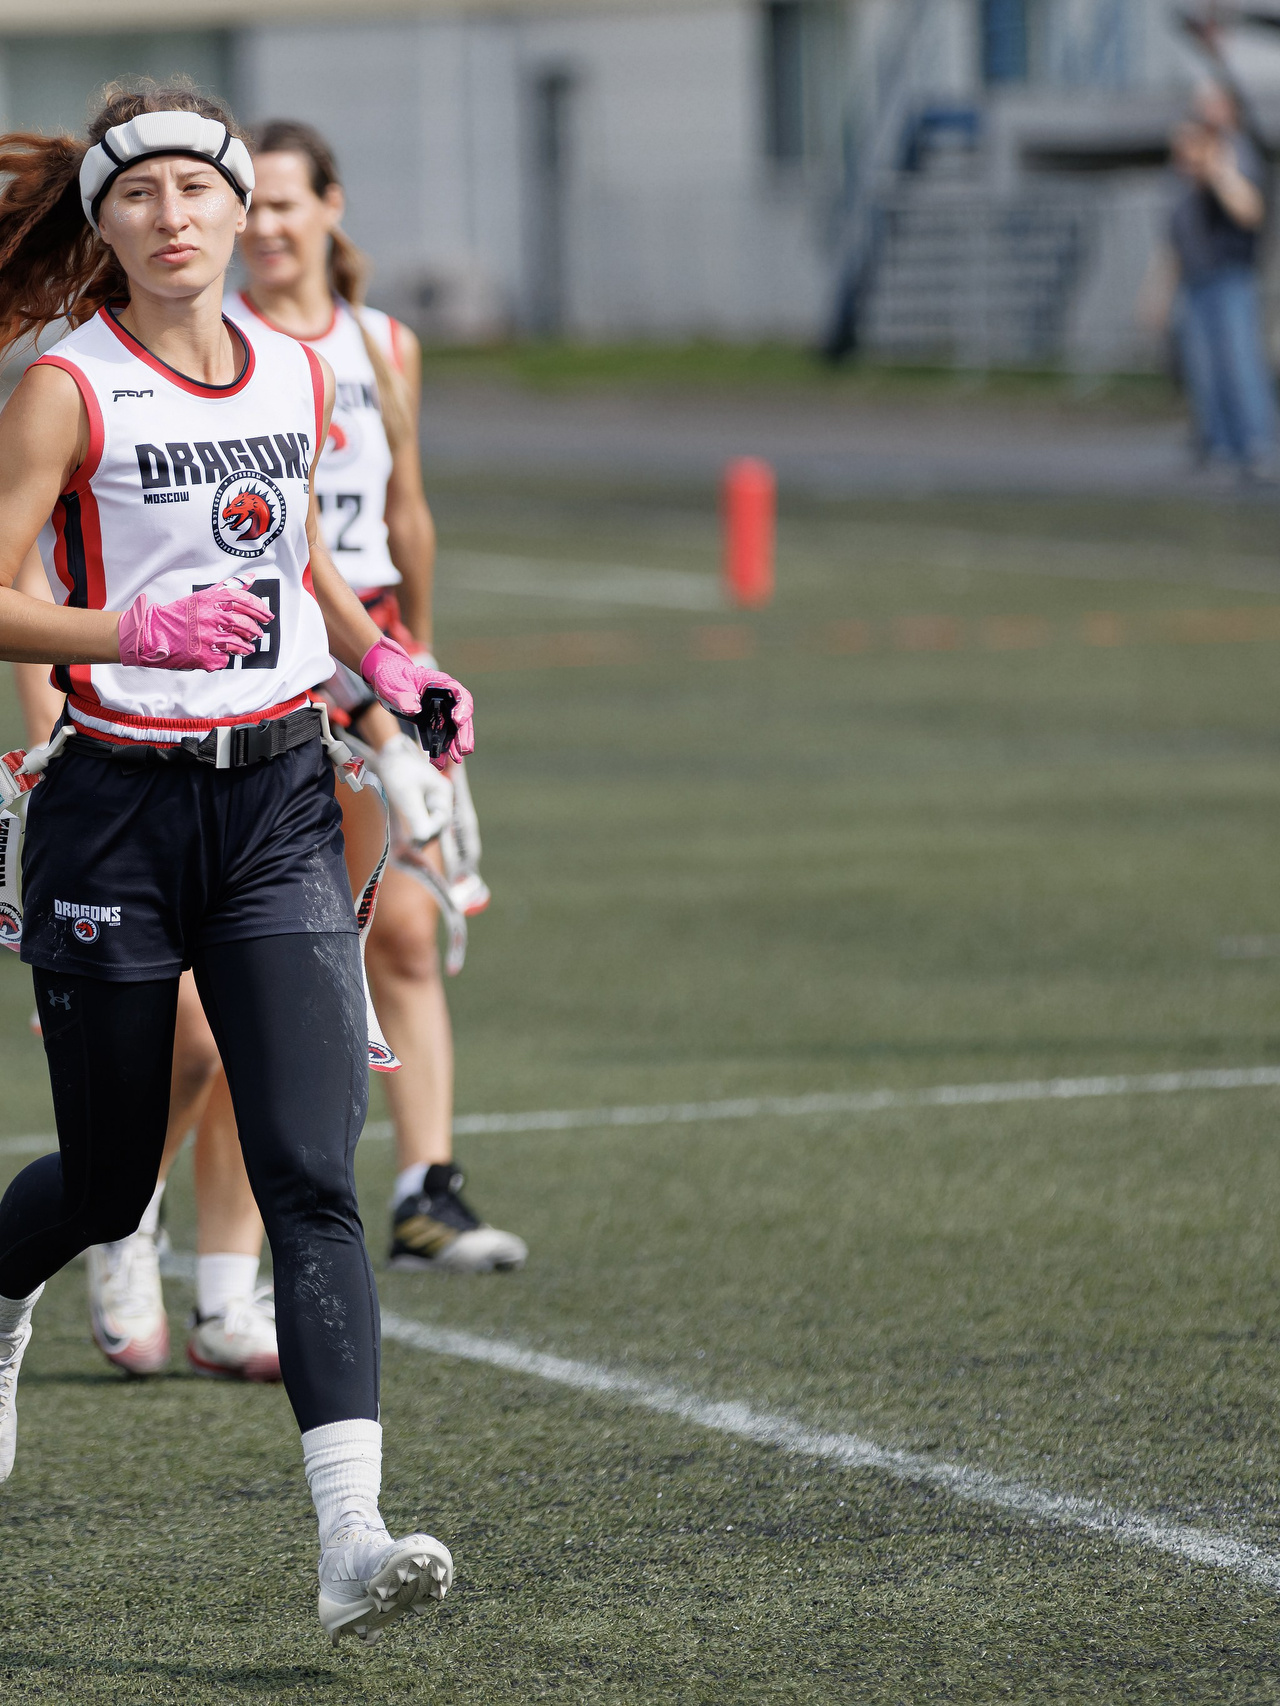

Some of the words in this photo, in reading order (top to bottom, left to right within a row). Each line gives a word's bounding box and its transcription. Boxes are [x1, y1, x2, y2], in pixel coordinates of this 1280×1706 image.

[134, 432, 310, 489] DRAGONS
[143, 491, 190, 505] MOSCOW
[54, 899, 121, 922] DRAGONS
